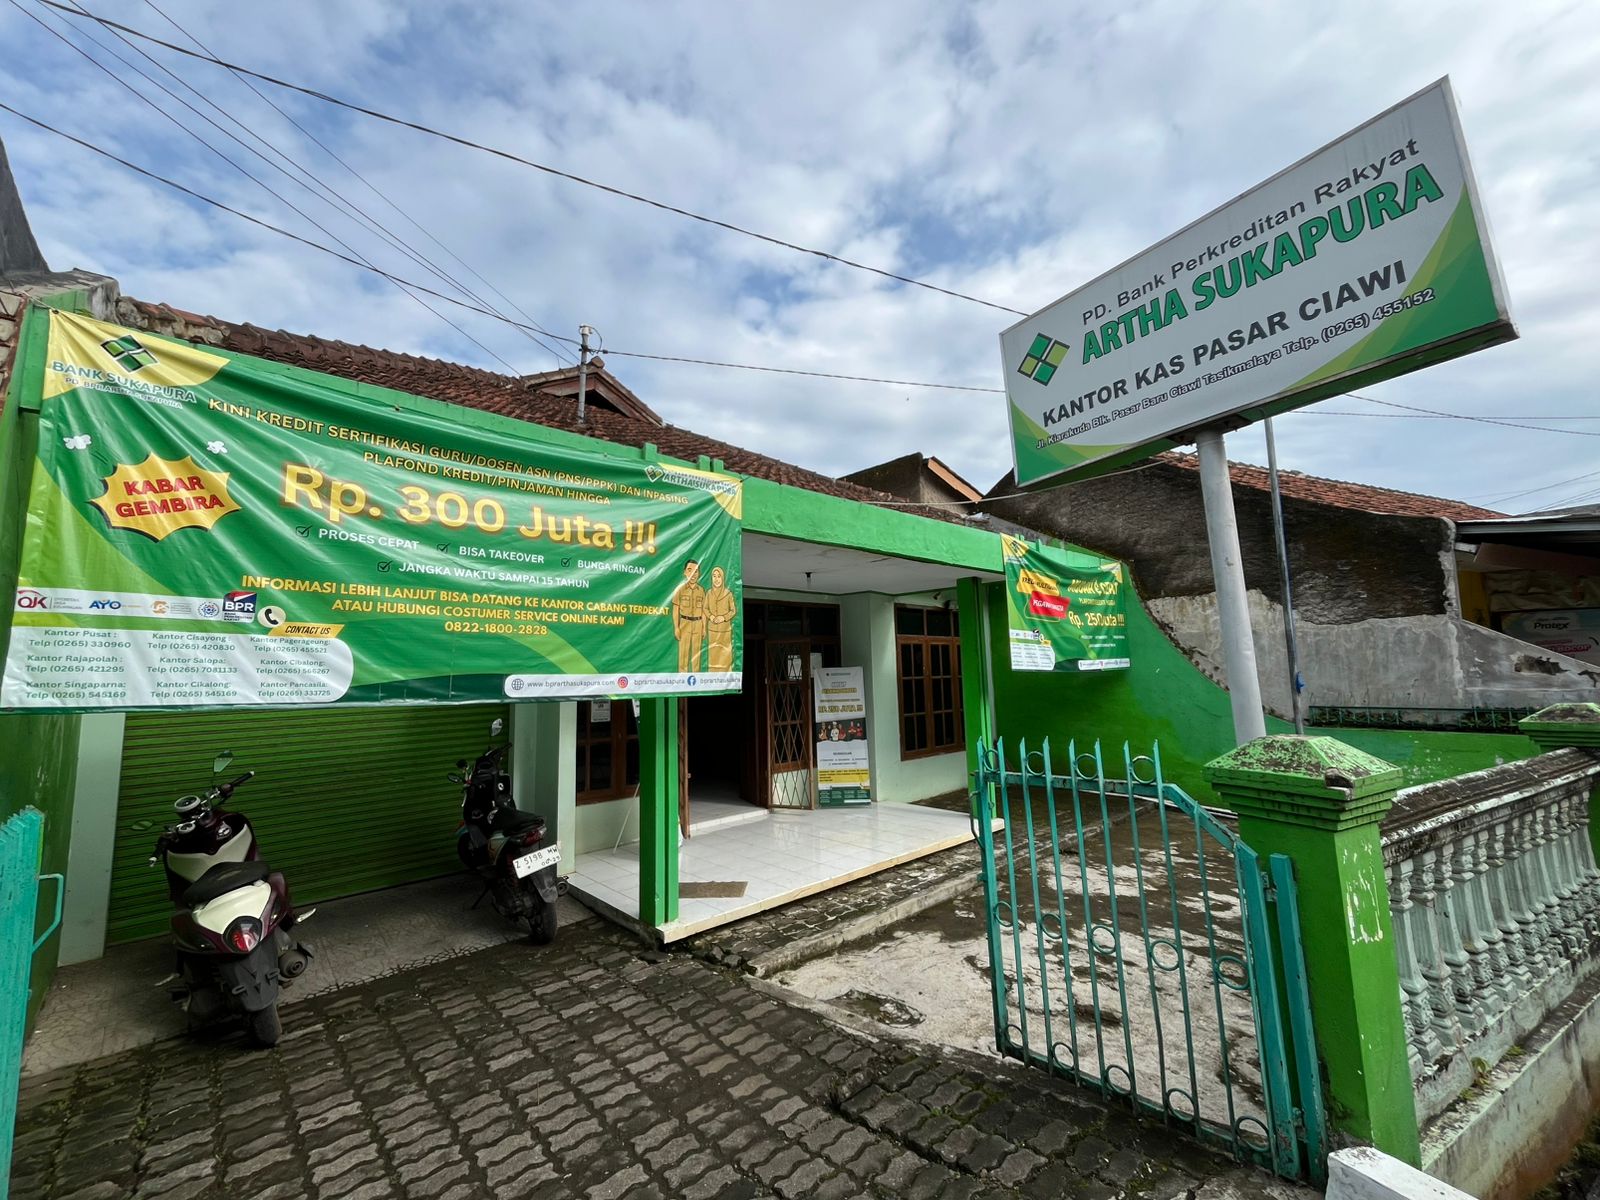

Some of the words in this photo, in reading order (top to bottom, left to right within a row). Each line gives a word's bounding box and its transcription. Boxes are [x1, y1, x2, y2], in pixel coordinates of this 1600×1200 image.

[1082, 303, 1112, 325] PD.
[1117, 274, 1166, 307] Bank
[1170, 200, 1306, 280] Perkreditan
[1314, 138, 1420, 205] Rakyat
[1082, 288, 1188, 365] ARTHA
[1192, 163, 1444, 311] SUKAPURA
[1042, 378, 1129, 427] KANTOR
[1134, 354, 1186, 389] KAS
[1192, 310, 1290, 367] PASAR
[1298, 260, 1407, 321] CIAWI
[1035, 440, 1046, 449] Jl.
[1048, 422, 1090, 445] Kiarakuda
[1092, 414, 1111, 429] Blk.
[1112, 402, 1141, 420] Pasar
[1142, 393, 1169, 409] Baru
[1169, 378, 1201, 398] Ciawi
[1202, 349, 1282, 386] Tasikmalaya
[1282, 336, 1319, 355] Telp.
[1321, 313, 1370, 343] (0265)
[1372, 287, 1436, 321] 455152
[52, 361, 104, 381] BANK
[106, 372, 197, 403] SUKAPURA
[208, 398, 251, 419] KINI
[256, 410, 324, 434] KREDIT
[328, 425, 426, 455] SERTIFIKASI
[429, 447, 523, 473] GURU/DOSEN
[526, 466, 551, 479] ASN
[554, 471, 618, 492] (PNS/PPPK)
[619, 484, 641, 497] DAN
[643, 487, 689, 504] INPASING
[123, 475, 205, 496] KABAR
[363, 452, 439, 474] PLAFOND
[442, 466, 564, 498] KREDIT/PINJAMAN
[566, 490, 611, 505] HINGGA
[115, 494, 225, 518] GEMBIRA
[283, 463, 382, 522] Rp.
[400, 484, 505, 533] 300
[519, 505, 615, 549] Juta
[623, 520, 657, 554] !!!
[318, 528, 376, 545] PROSES
[378, 536, 420, 550] CEPAT
[459, 546, 486, 558] BISA
[488, 549, 545, 564] TAKEOVER
[399, 562, 452, 576] JANGKA
[453, 567, 495, 580] WAKTU
[498, 572, 540, 584] SAMPAI
[542, 576, 554, 586] 15
[555, 577, 590, 588] TAHUN
[577, 559, 611, 571] BUNGA
[612, 562, 646, 575] RINGAN
[17, 596, 48, 609] OJK
[241, 575, 336, 594] INFORMASI
[340, 583, 381, 597] LEBIH
[385, 587, 437, 600] LANJUT
[440, 591, 469, 603] BISA
[472, 593, 522, 607] DATANG
[524, 597, 539, 608] KE
[541, 598, 585, 611] KANTOR
[586, 601, 627, 614] CABANG
[629, 604, 670, 616] TERDEKAT
[88, 600, 122, 610] AYO
[223, 601, 254, 612] BPR
[331, 600, 373, 612] ATAU
[377, 602, 440, 616] HUBUNGI
[443, 606, 511, 620] COSTUMER
[514, 610, 559, 622] SERVICE
[560, 612, 598, 624] ONLINE
[600, 614, 625, 626] KAMI
[444, 621, 548, 636] 0822-1800-2828
[1068, 611, 1084, 629] Rp.
[44, 629, 80, 637] Kantor
[83, 630, 111, 638] Pusat
[186, 634, 226, 642] Cisayong
[284, 625, 320, 635] CONTACT
[320, 627, 331, 635] US
[29, 639, 51, 648] Telp
[53, 639, 88, 648] (0265)
[26, 654, 63, 662] Kantor
[65, 655, 118, 663] Rajapolah
[25, 665, 47, 673] Telp
[50, 665, 85, 673] (0265)
[147, 666, 167, 674] Telp
[169, 666, 200, 674] (0265)
[255, 667, 273, 675] Telp
[25, 692, 49, 700] Telp
[52, 691, 86, 699] (0265)
[151, 691, 170, 699] Telp
[257, 690, 275, 698] Telp
[515, 861, 521, 869] Z
[524, 852, 543, 865] 5198
